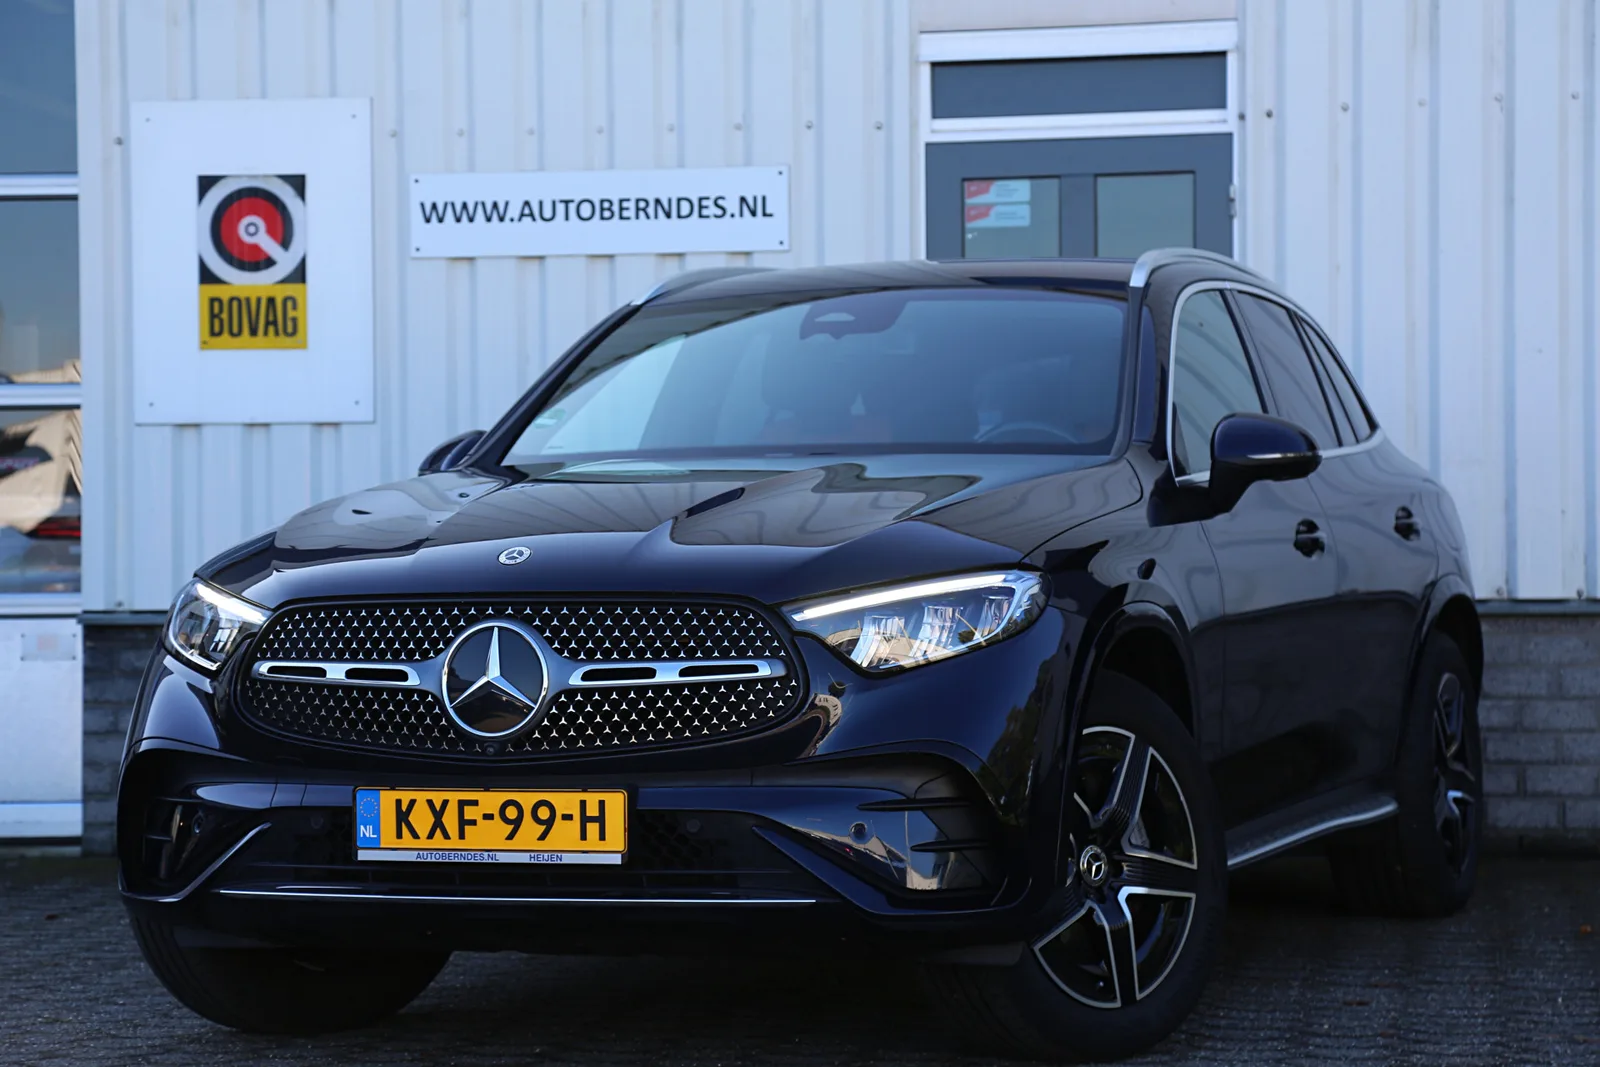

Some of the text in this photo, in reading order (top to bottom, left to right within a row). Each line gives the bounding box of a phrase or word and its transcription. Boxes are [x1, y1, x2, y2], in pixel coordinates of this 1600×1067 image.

[420, 195, 774, 223] WWW.AUTOBERNDES.NL
[208, 295, 298, 338] BOVAG
[360, 826, 377, 838] NL
[394, 798, 606, 841] KXF-99-H
[415, 851, 563, 863] AUTOBERNDES.NL HEIJEN
